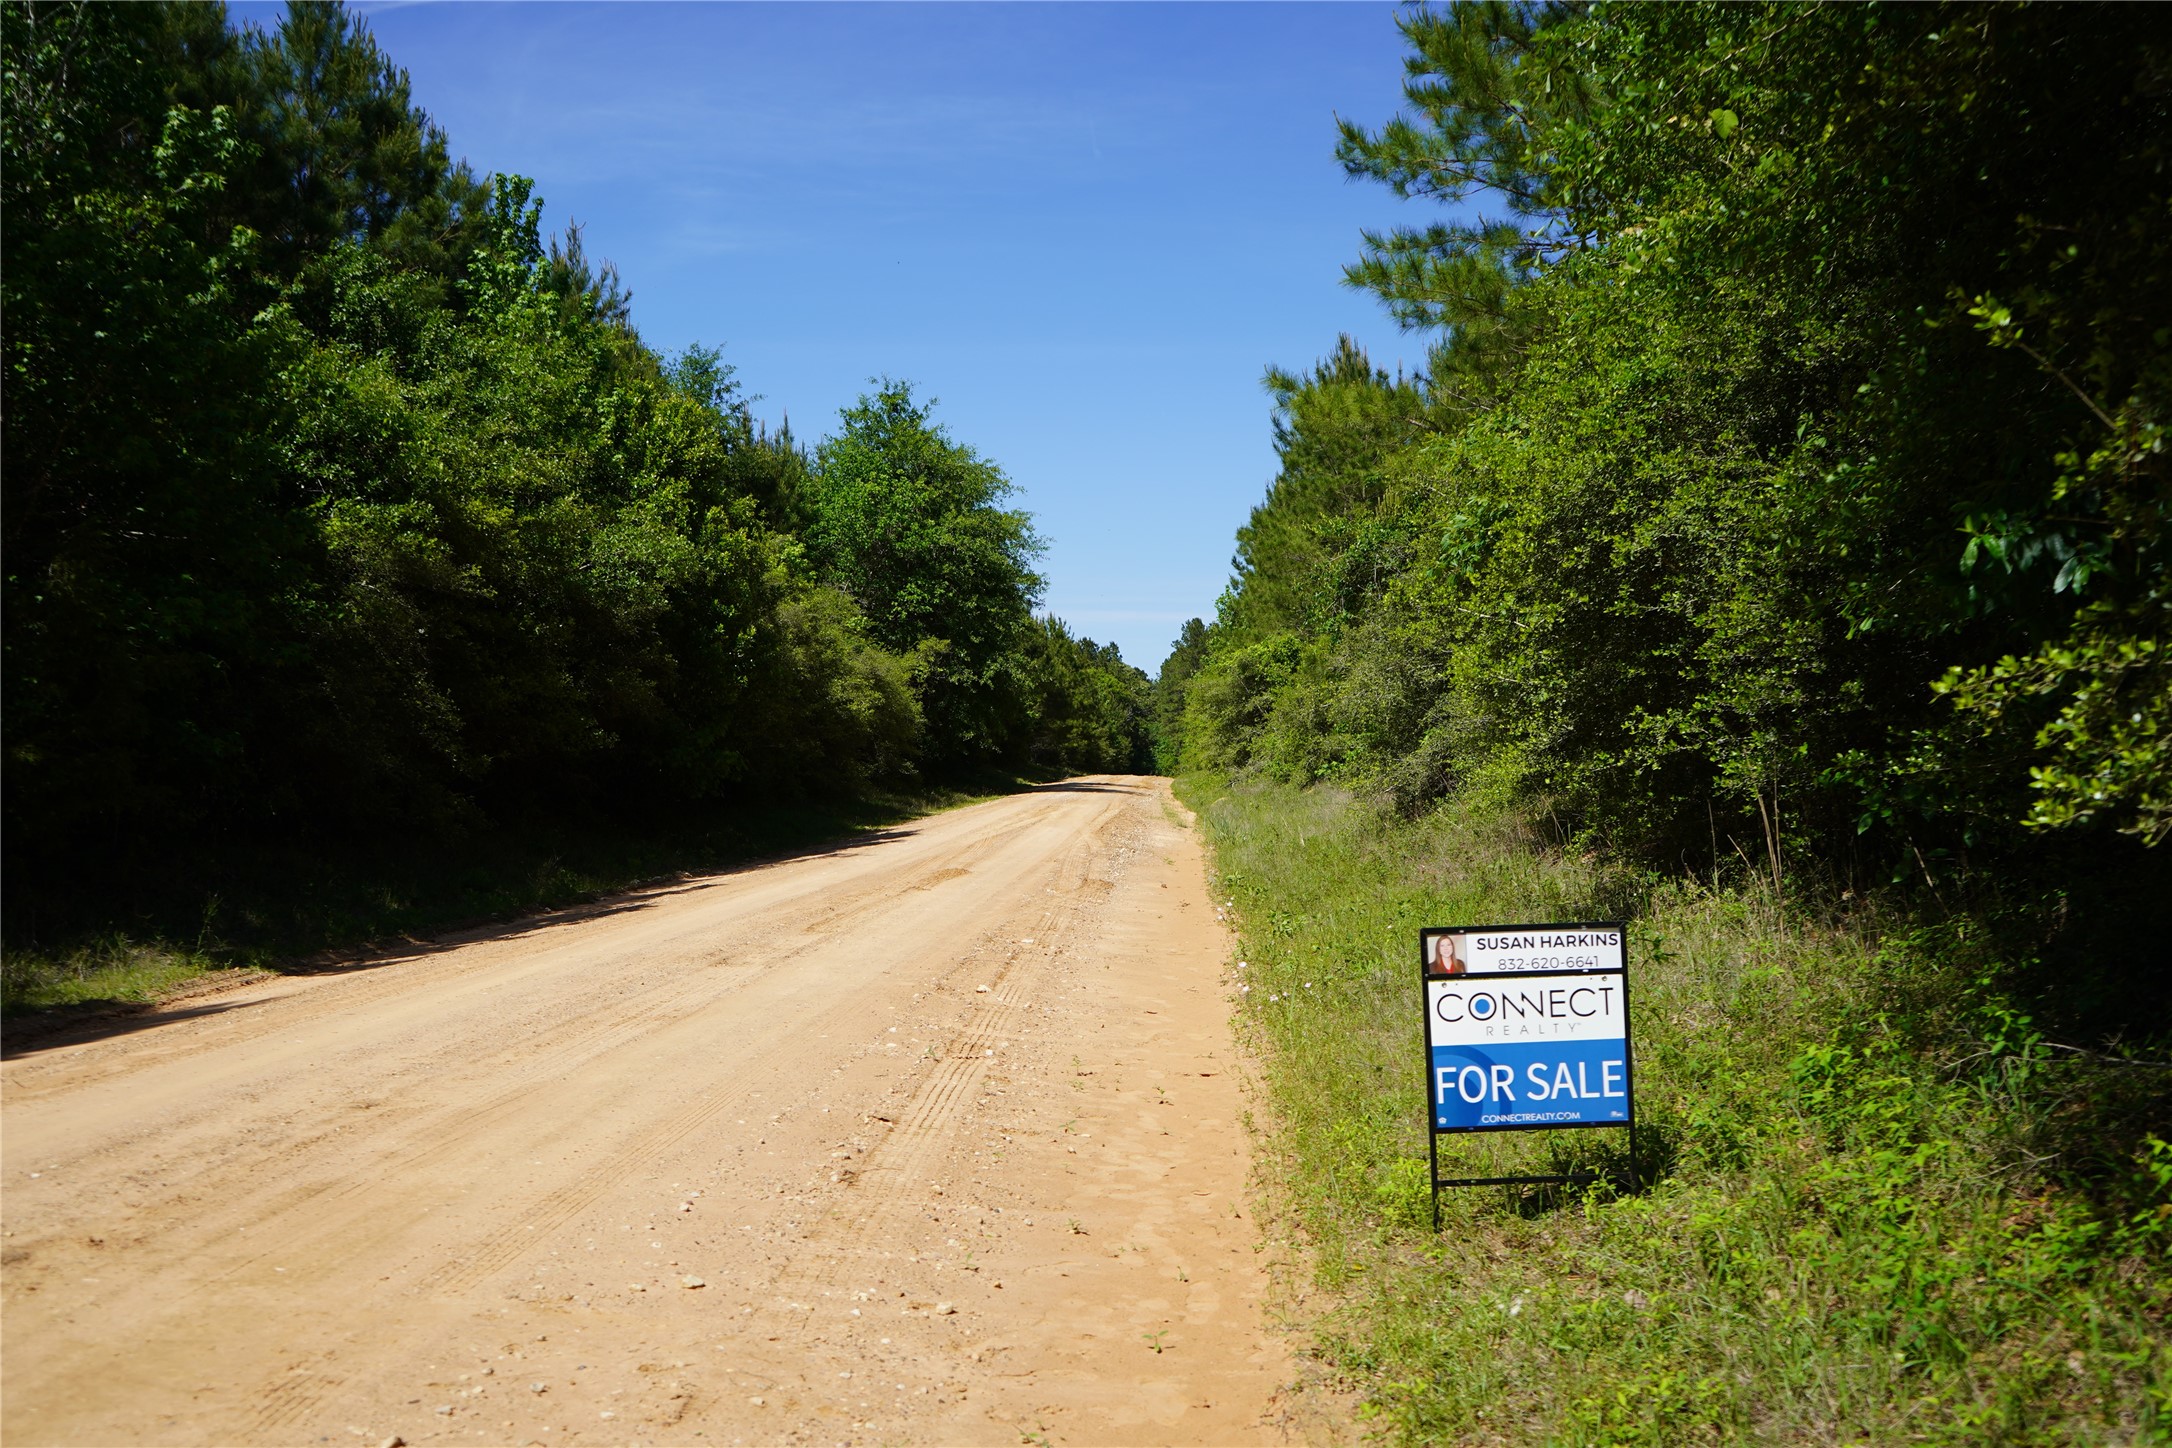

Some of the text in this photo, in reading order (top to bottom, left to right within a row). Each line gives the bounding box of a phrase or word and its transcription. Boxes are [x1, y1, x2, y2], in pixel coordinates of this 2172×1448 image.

[1476, 933, 1619, 951] SUSAN HARKINS
[1498, 955, 1599, 970] 832-620-6641
[1436, 987, 1614, 1023] CONNECT
[1436, 1060, 1625, 1105] FOR SALE
[1481, 1111, 1581, 1124] CONNECTREALTY.COM
